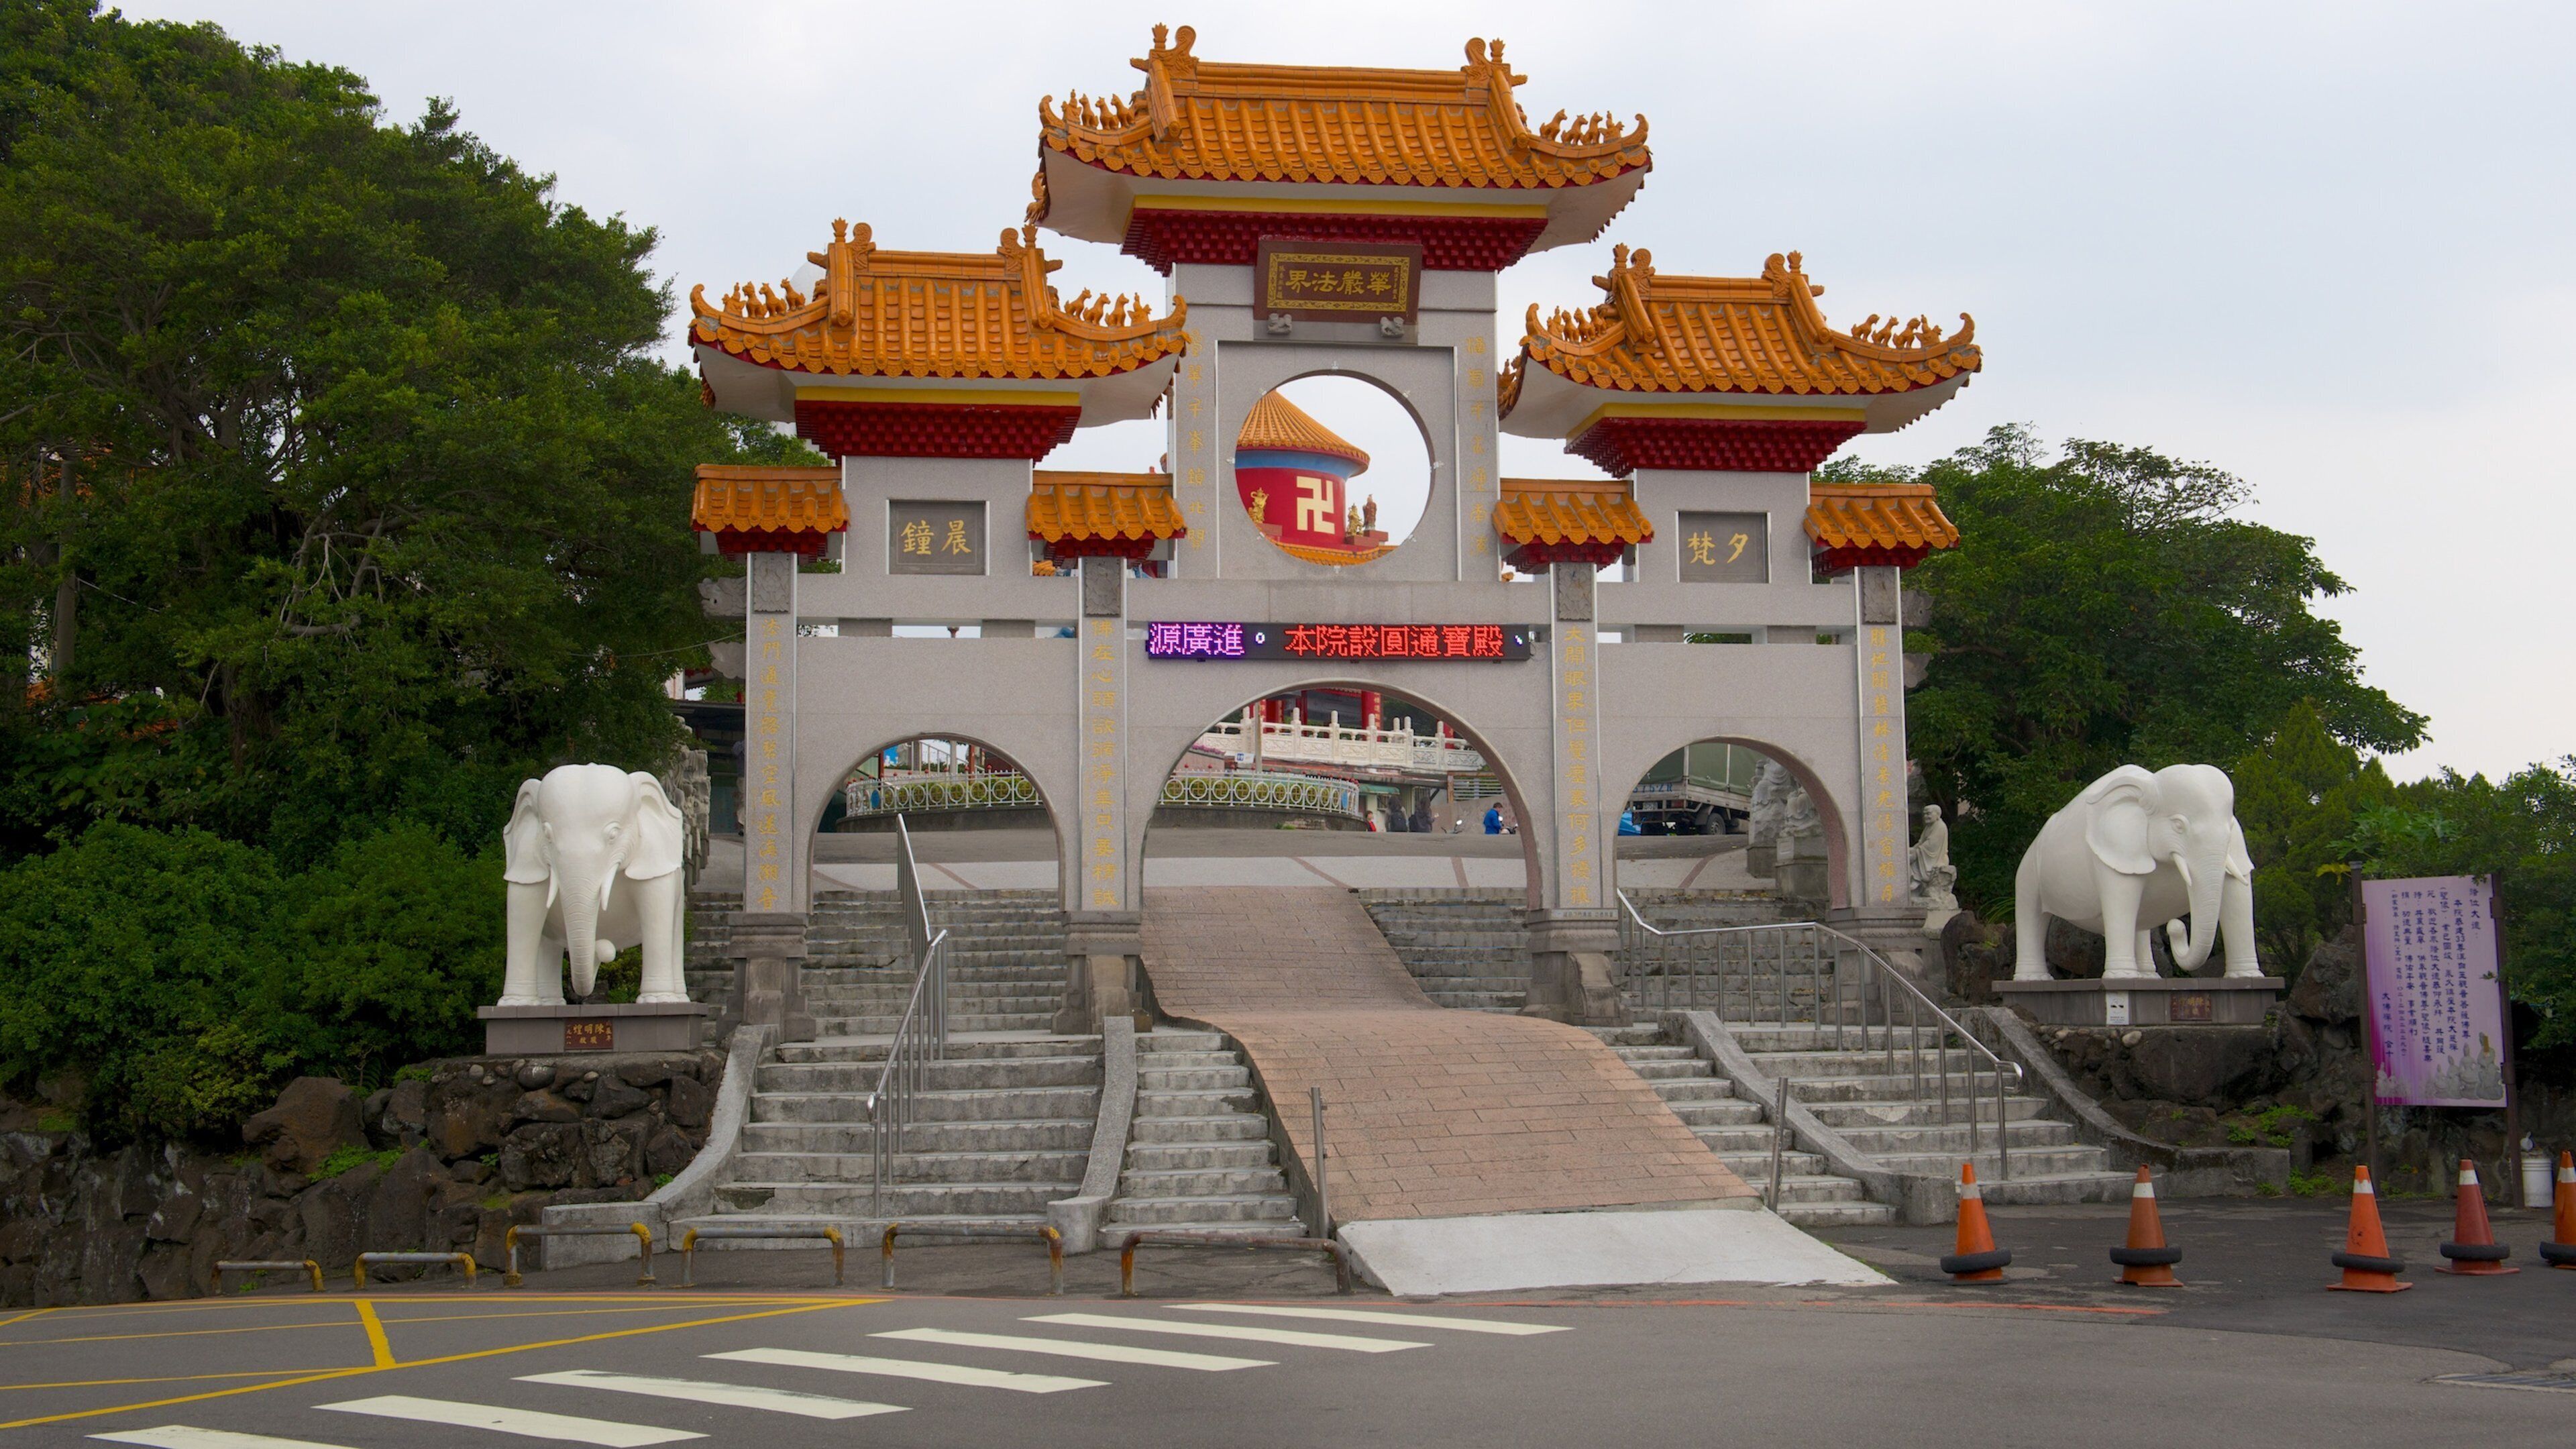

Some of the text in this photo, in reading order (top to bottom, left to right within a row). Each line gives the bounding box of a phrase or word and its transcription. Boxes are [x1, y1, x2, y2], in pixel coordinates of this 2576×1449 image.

[1286, 270, 1392, 295] 華嚴法界
[900, 520, 972, 555] 晨鐘
[1687, 531, 1749, 565] 夕梵
